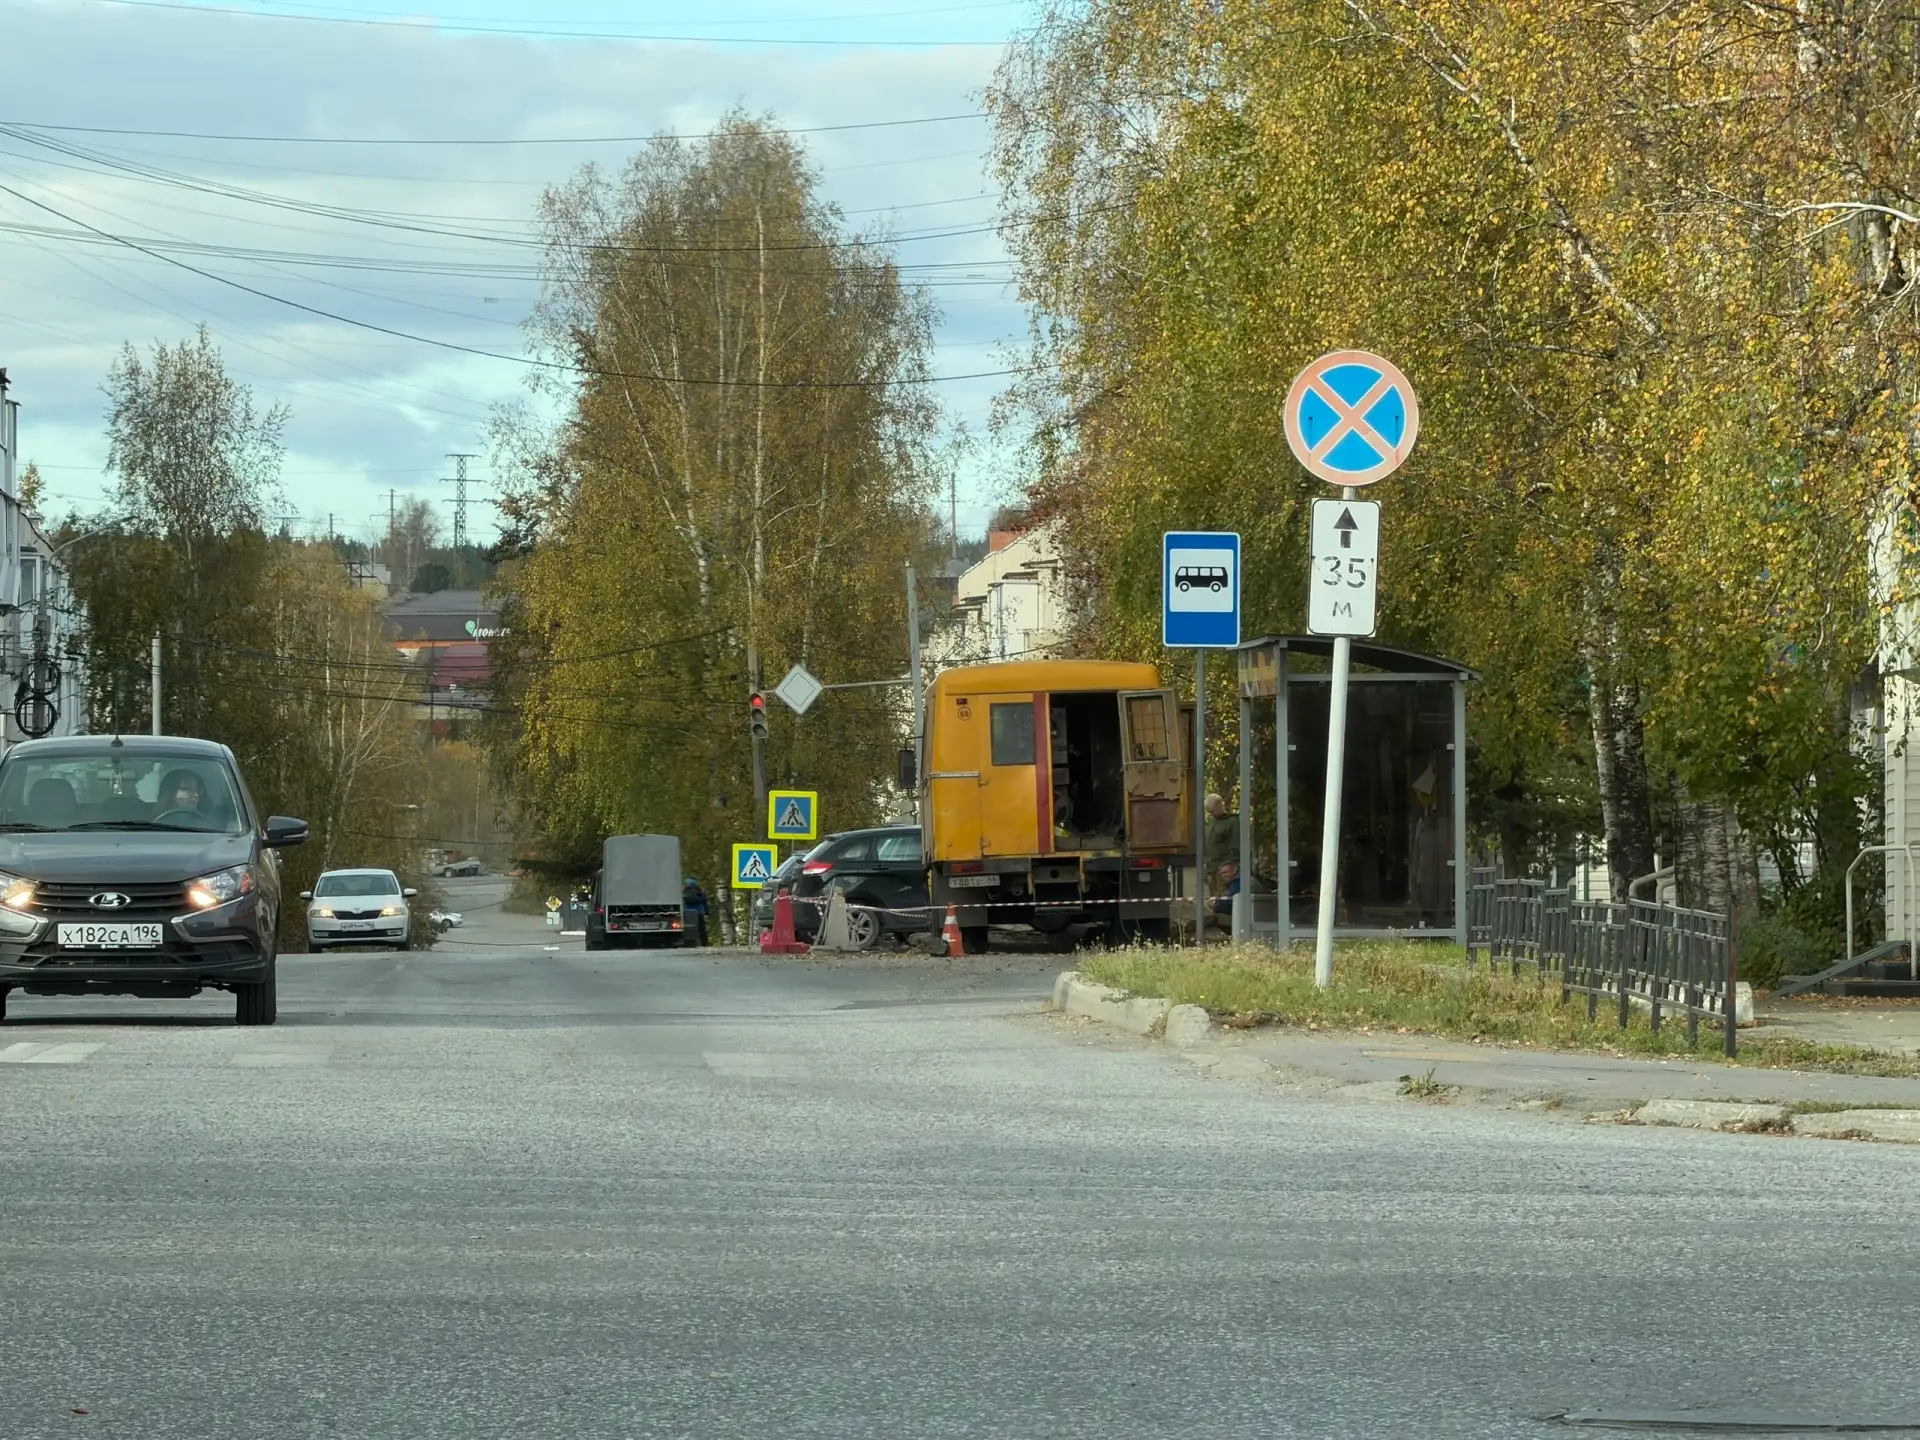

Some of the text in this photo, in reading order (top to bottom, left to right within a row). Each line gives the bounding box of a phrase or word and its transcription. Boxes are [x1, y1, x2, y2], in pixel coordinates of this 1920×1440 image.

[1322, 556, 1367, 588] 35
[63, 925, 160, 943] Х182СА 196
